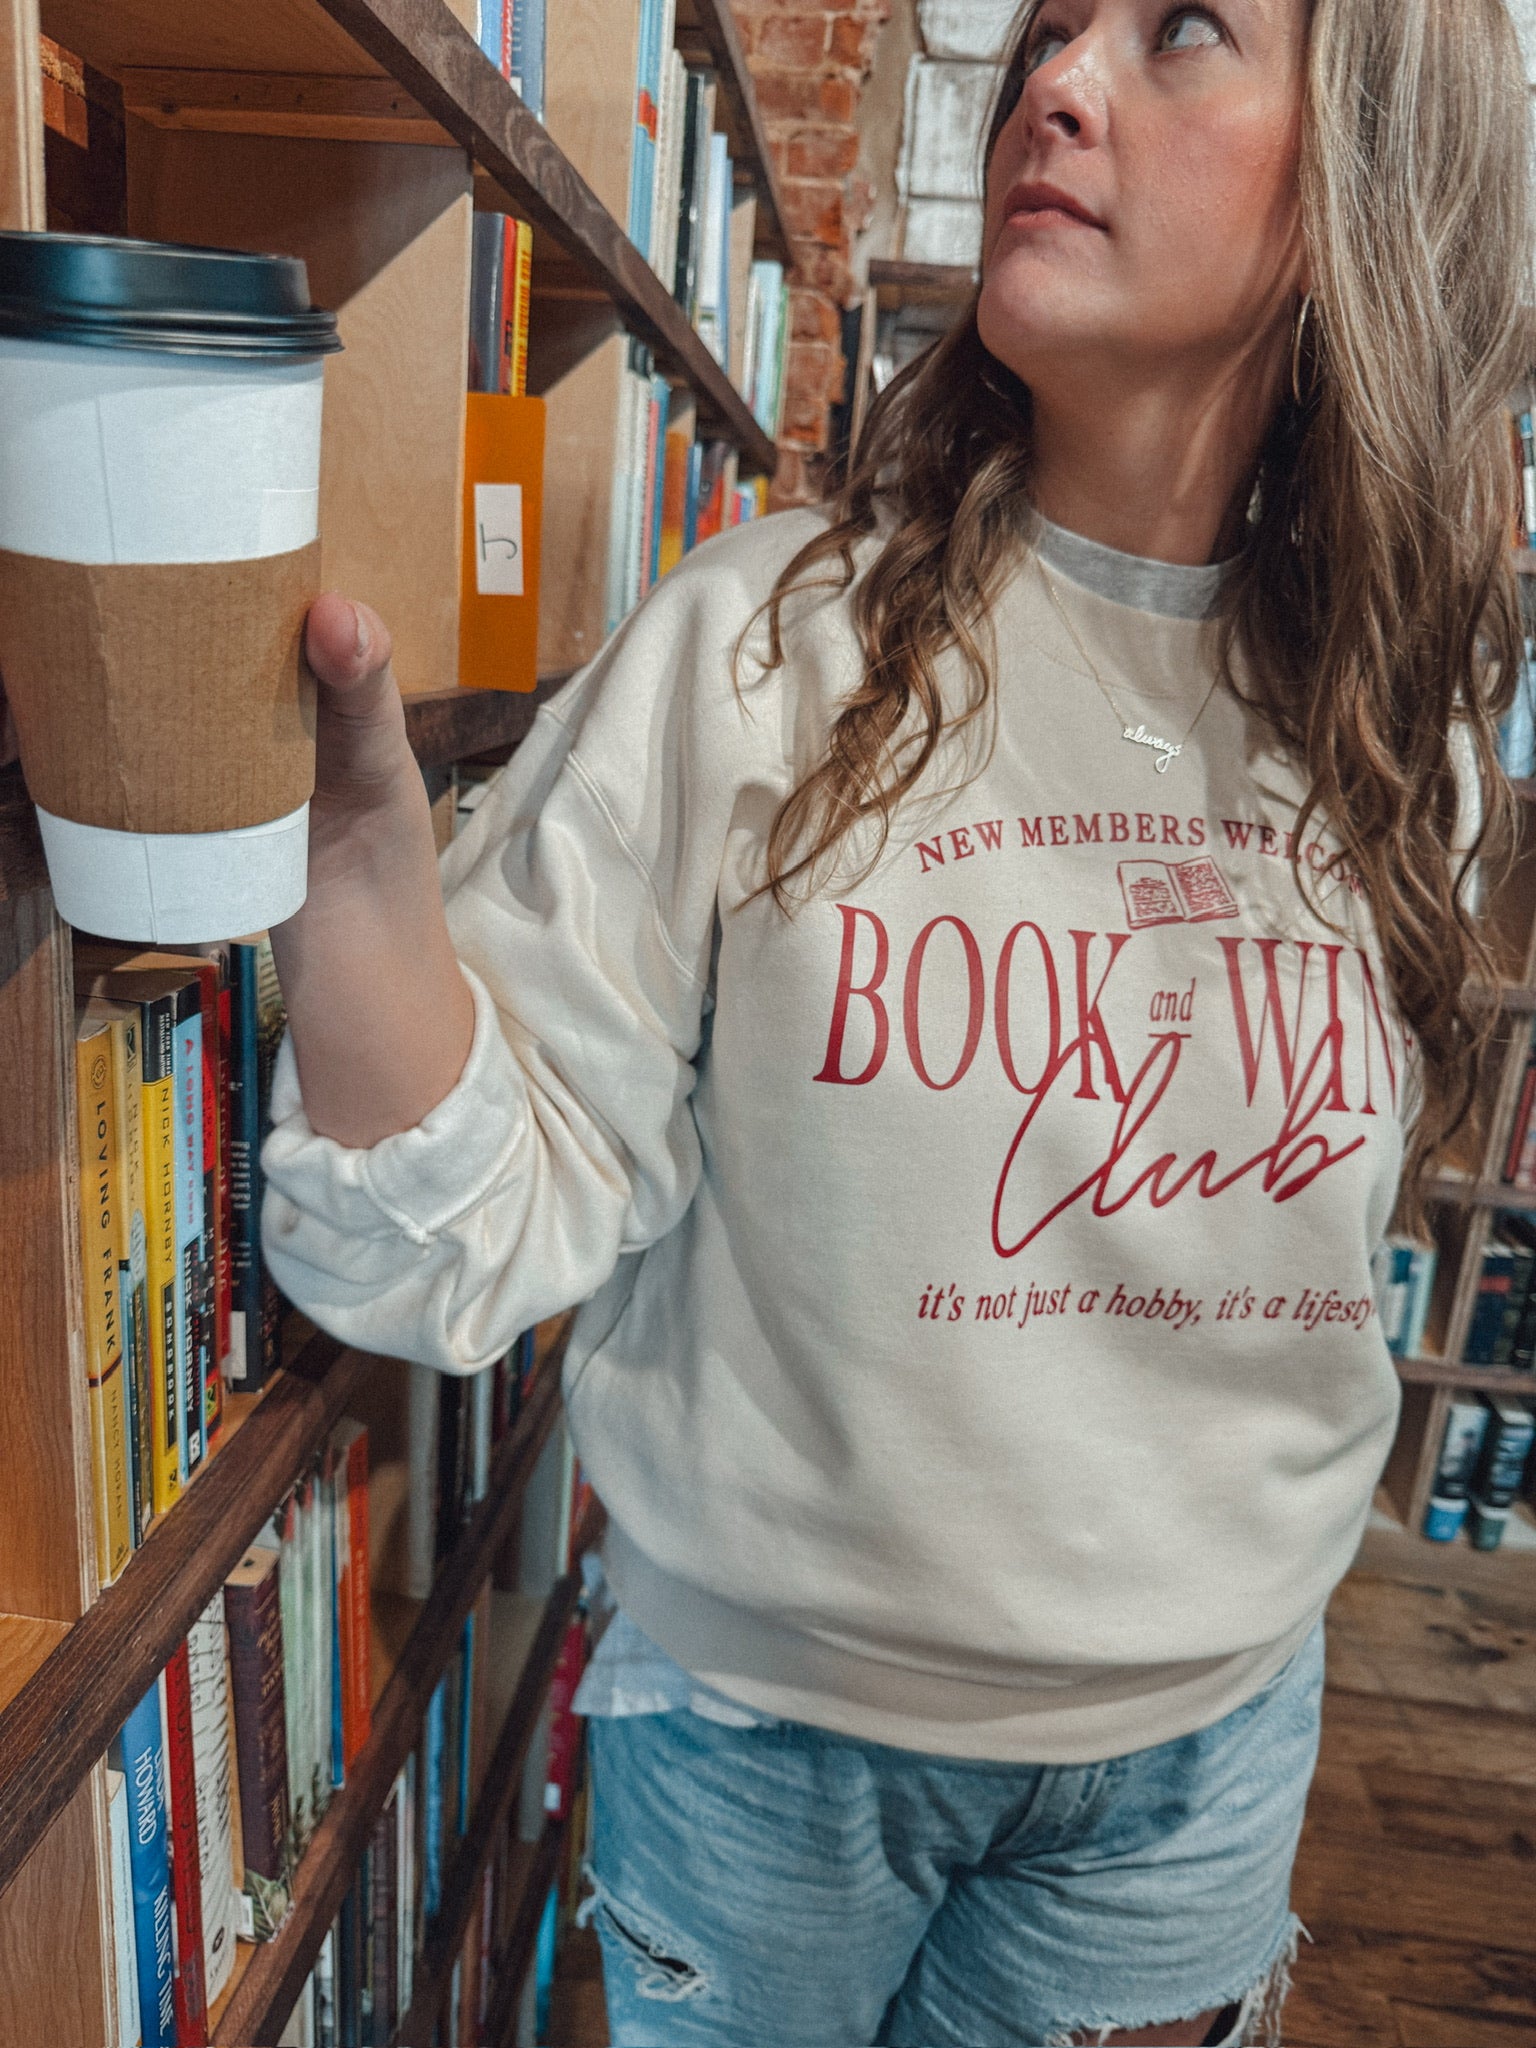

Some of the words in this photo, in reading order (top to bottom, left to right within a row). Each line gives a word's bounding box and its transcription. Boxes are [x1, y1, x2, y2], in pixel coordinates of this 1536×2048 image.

[1122, 724, 1183, 773] always
[914, 819, 1004, 873] NEW
[1020, 812, 1206, 847] MEMBERS
[1220, 819, 1364, 895] WELCO
[185, 1038, 194, 1056] A
[812, 902, 1132, 1104] BOOK
[1149, 977, 1196, 1023] and
[1215, 936, 1412, 1119] WIN
[97, 1100, 111, 1229] LOVING
[162, 1087, 171, 1148] NICK
[991, 1016, 1366, 1258] Club
[162, 1161, 172, 1263] HORNBY
[103, 1247, 116, 1353] FRANK
[184, 1250, 193, 1311] NICK
[917, 1282, 962, 1321] it's
[975, 1285, 1017, 1321] not
[1016, 1280, 1072, 1329] just
[1076, 1288, 1101, 1315] a
[1104, 1282, 1202, 1329] hobby,
[1216, 1284, 1253, 1320] it's
[1261, 1293, 1286, 1320] a
[1291, 1287, 1376, 1332] lifesty
[165, 1301, 175, 1419] SONGBOOK
[185, 1316, 194, 1412] HORNBY
[111, 1389, 120, 1448] NANCY
[134, 1745, 157, 1845] HOWARD
[154, 1885, 171, 1979] KILLING
[158, 1970, 174, 2037] TIME
